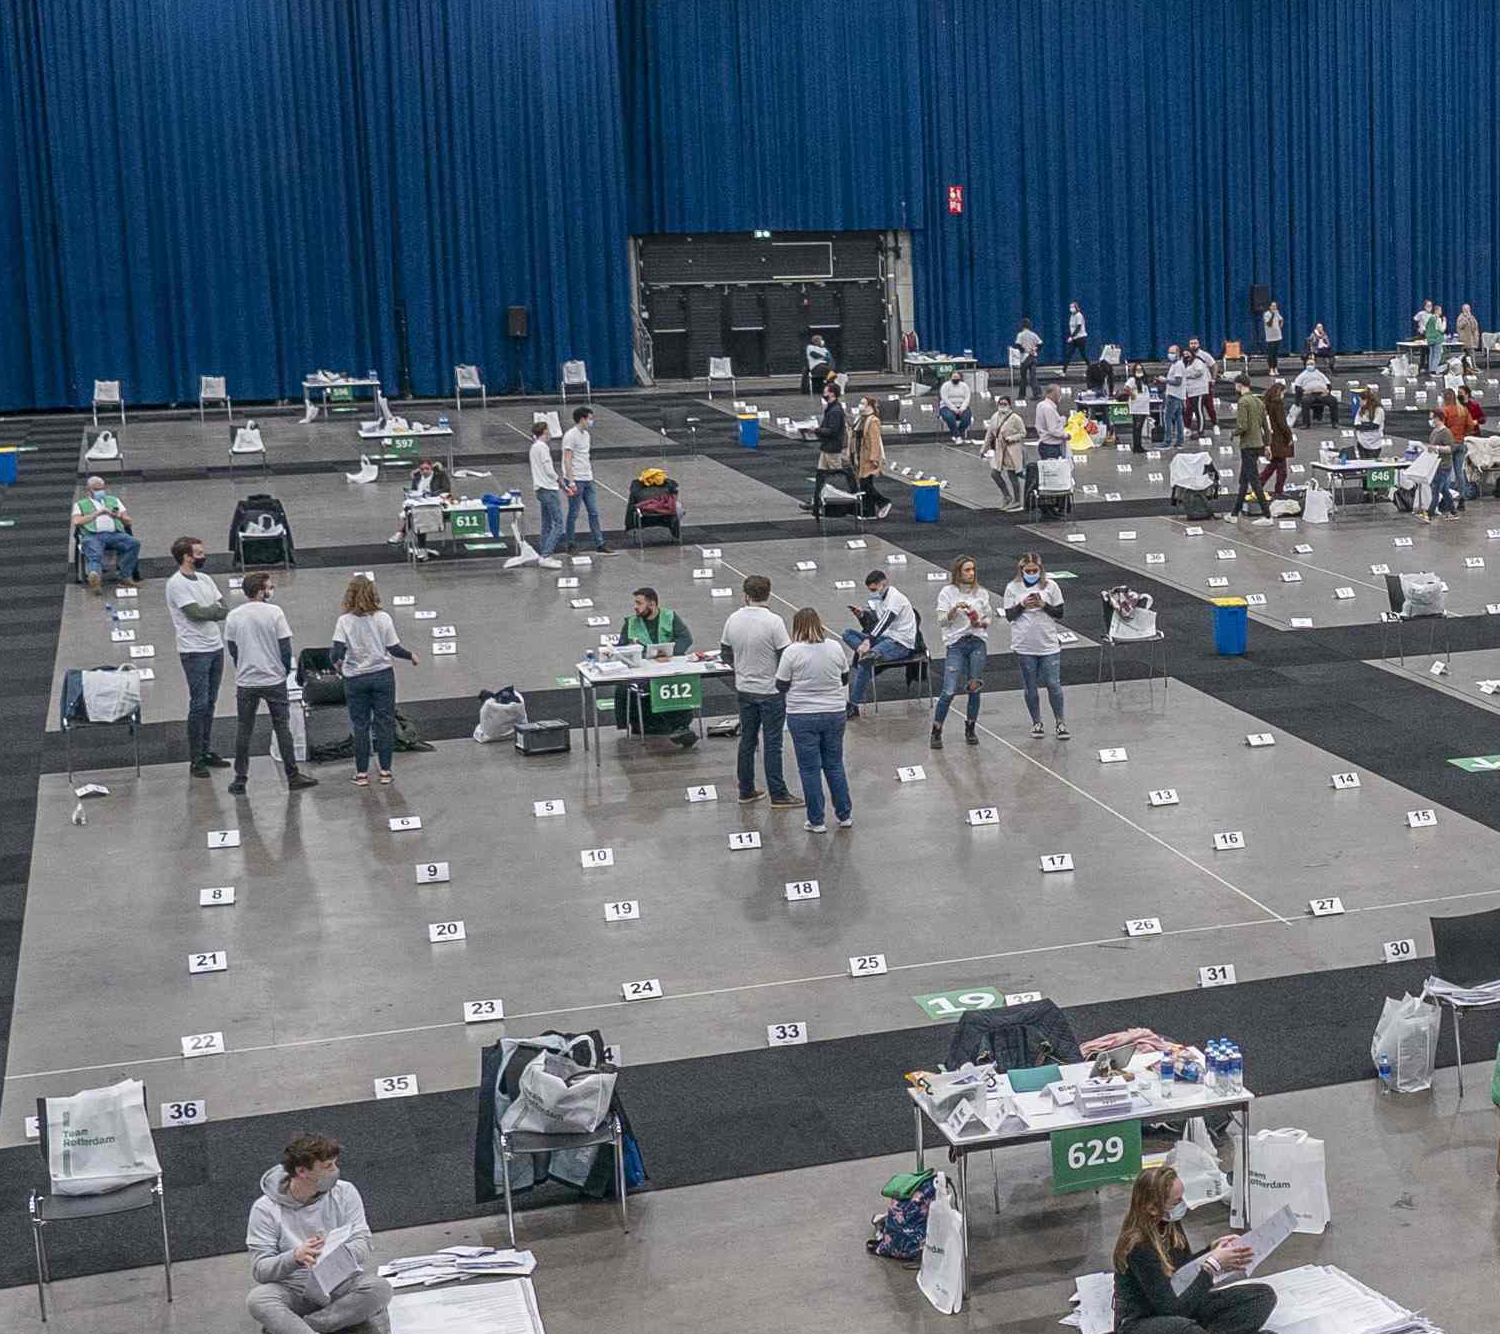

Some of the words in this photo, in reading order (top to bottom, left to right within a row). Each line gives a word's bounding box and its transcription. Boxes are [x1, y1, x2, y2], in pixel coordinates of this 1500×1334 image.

[1372, 471, 1389, 481] 646
[457, 516, 478, 526] 611
[660, 683, 692, 699] 612
[907, 768, 915, 776] 3
[1339, 774, 1354, 783] 14
[1156, 791, 1172, 799] 13
[546, 802, 554, 811] 5
[976, 810, 993, 819] 12
[1414, 811, 1430, 820] 15
[220, 832, 228, 842] 7
[737, 834, 752, 843] 11
[1221, 834, 1238, 843] 16
[589, 851, 606, 861] 10
[1049, 856, 1065, 865] 17
[428, 865, 437, 876] 9
[794, 883, 812, 894] 18
[212, 890, 222, 899] 8
[612, 903, 631, 915] 19
[1317, 900, 1333, 910] 27
[437, 924, 457, 935] 20
[1134, 921, 1153, 930] 26
[1391, 940, 1409, 955] 30
[197, 954, 216, 966] 21
[858, 957, 879, 970] 25
[1207, 967, 1226, 980] 31
[631, 982, 653, 994] 24
[472, 1002, 495, 1014] 23
[924, 993, 995, 1014] 19
[776, 1025, 799, 1039] 33
[191, 1036, 216, 1050] 22
[383, 1077, 408, 1091] 35
[170, 1103, 196, 1119] 36
[1068, 1137, 1123, 1168] 629
[1249, 1170, 1267, 1180] eam
[1249, 1178, 1291, 1189] otterdam
